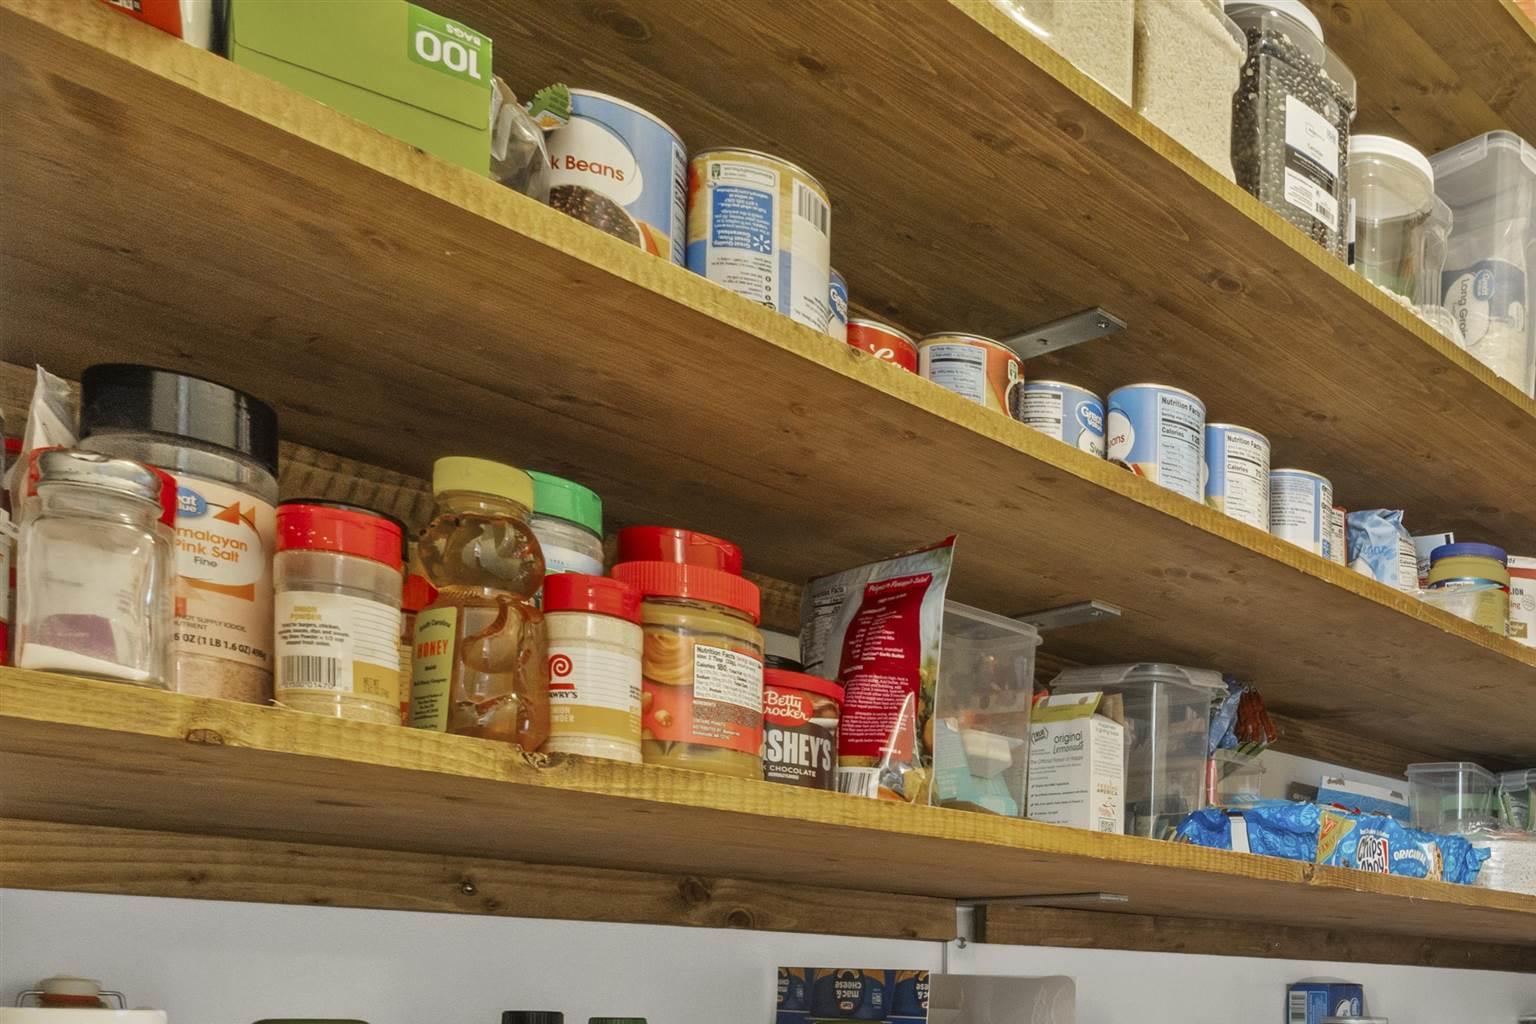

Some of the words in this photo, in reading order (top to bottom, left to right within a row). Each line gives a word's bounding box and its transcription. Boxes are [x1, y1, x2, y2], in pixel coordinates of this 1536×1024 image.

[415, 30, 481, 80] 100
[565, 155, 625, 181] Beans
[1459, 278, 1471, 307] Long
[175, 528, 248, 553] malayan
[175, 541, 207, 556] Pink
[211, 545, 240, 563] Salt
[193, 556, 218, 568] Fine
[183, 634, 196, 645] OZ
[197, 635, 208, 646] (1
[209, 637, 222, 648] LB
[223, 639, 237, 652] 1.6
[416, 639, 449, 659] HONEY
[696, 646, 721, 657] Nutrition
[765, 691, 803, 711] Betty
[764, 705, 811, 722] rocker
[1054, 730, 1083, 745] original
[763, 728, 832, 772] SHEY'S
[769, 765, 817, 779] CHOCOLATE
[1357, 837, 1384, 862] Chips
[1393, 849, 1426, 865] ORIGINAL
